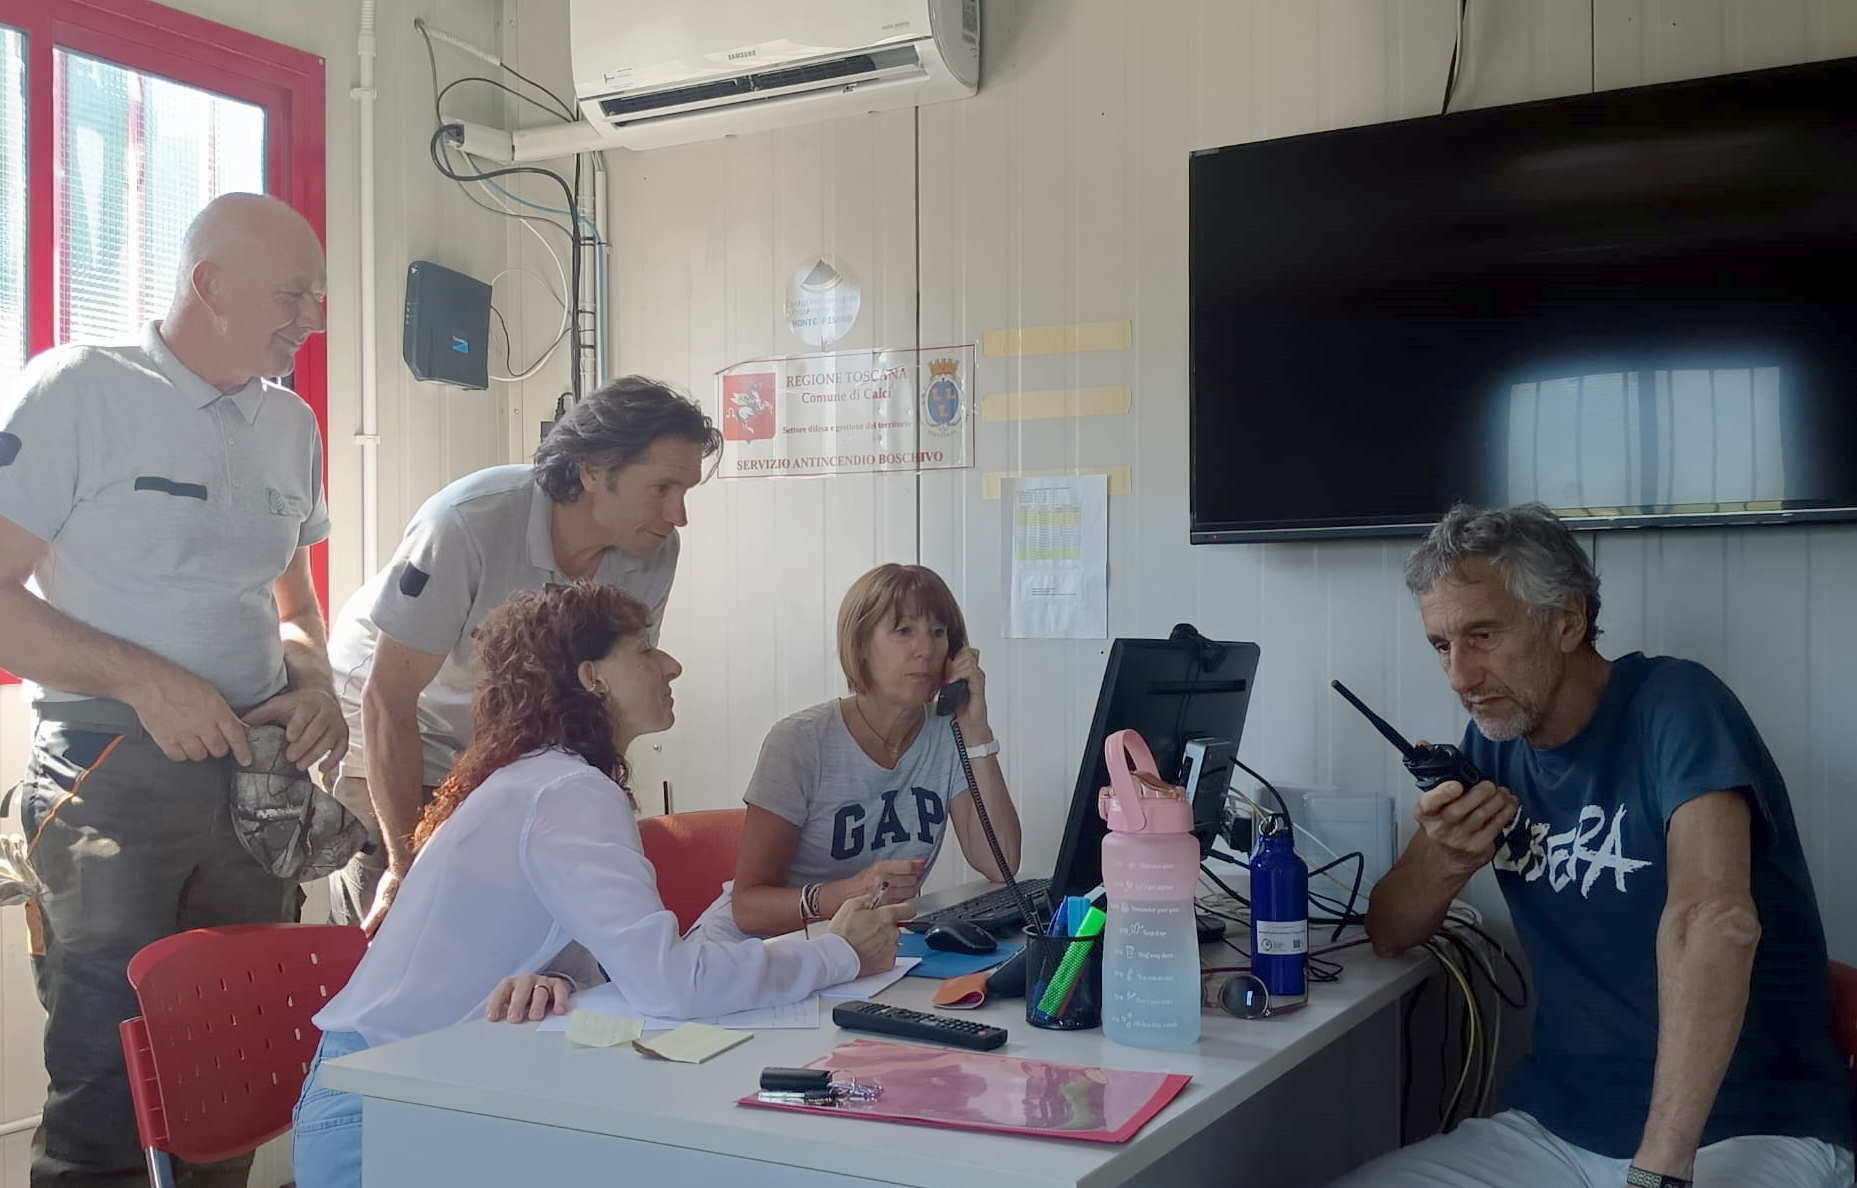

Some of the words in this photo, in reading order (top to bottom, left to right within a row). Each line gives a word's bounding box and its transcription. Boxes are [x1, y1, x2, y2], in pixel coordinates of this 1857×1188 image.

[786, 372, 841, 388] REGIONE
[845, 367, 908, 384] TOSCANA
[801, 391, 847, 404] Comune
[849, 389, 860, 401] di
[863, 386, 892, 400] Calci
[736, 459, 791, 471] SERVIZIO
[791, 454, 875, 468] ANTINCENDIO
[878, 451, 943, 465] BOSCHIVO
[830, 786, 945, 860] GAP
